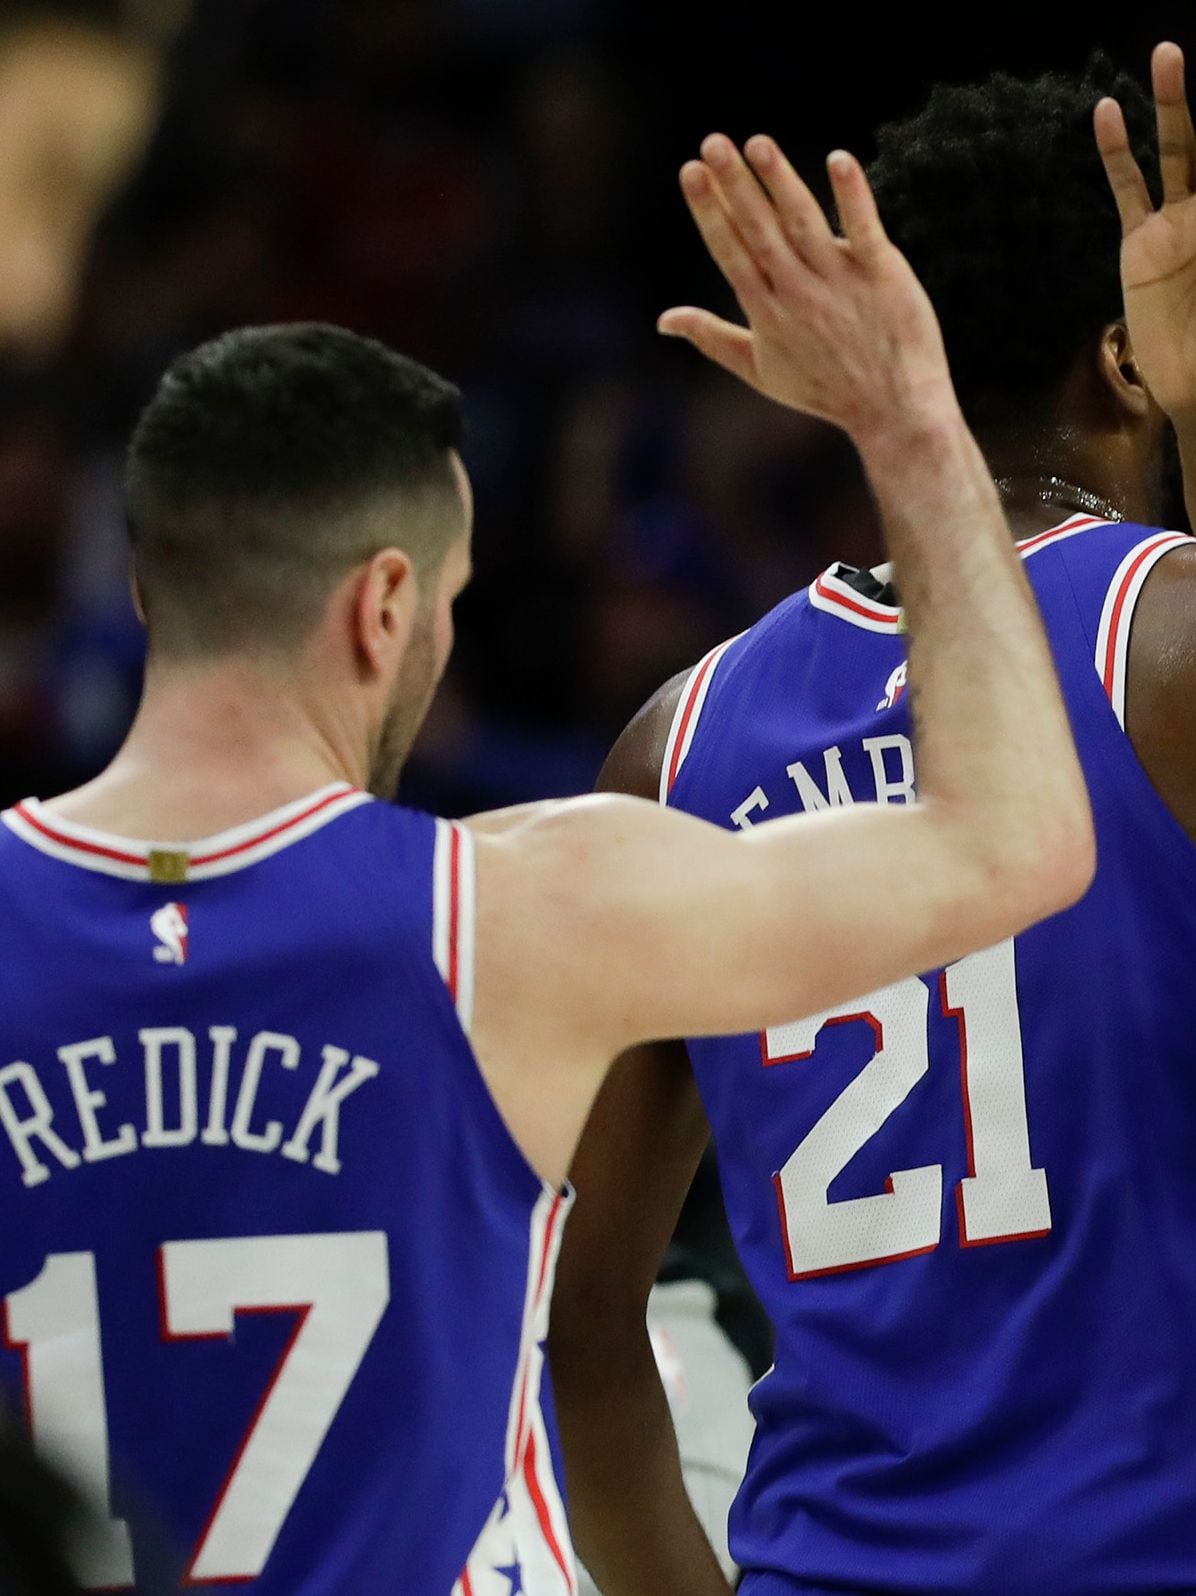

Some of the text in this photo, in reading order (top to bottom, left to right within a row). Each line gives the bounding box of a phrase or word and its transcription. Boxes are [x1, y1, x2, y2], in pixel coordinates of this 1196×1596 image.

[0, 1025, 380, 1188] REDICK
[760, 936, 1052, 1282] 21
[2, 1231, 391, 1590] 17
